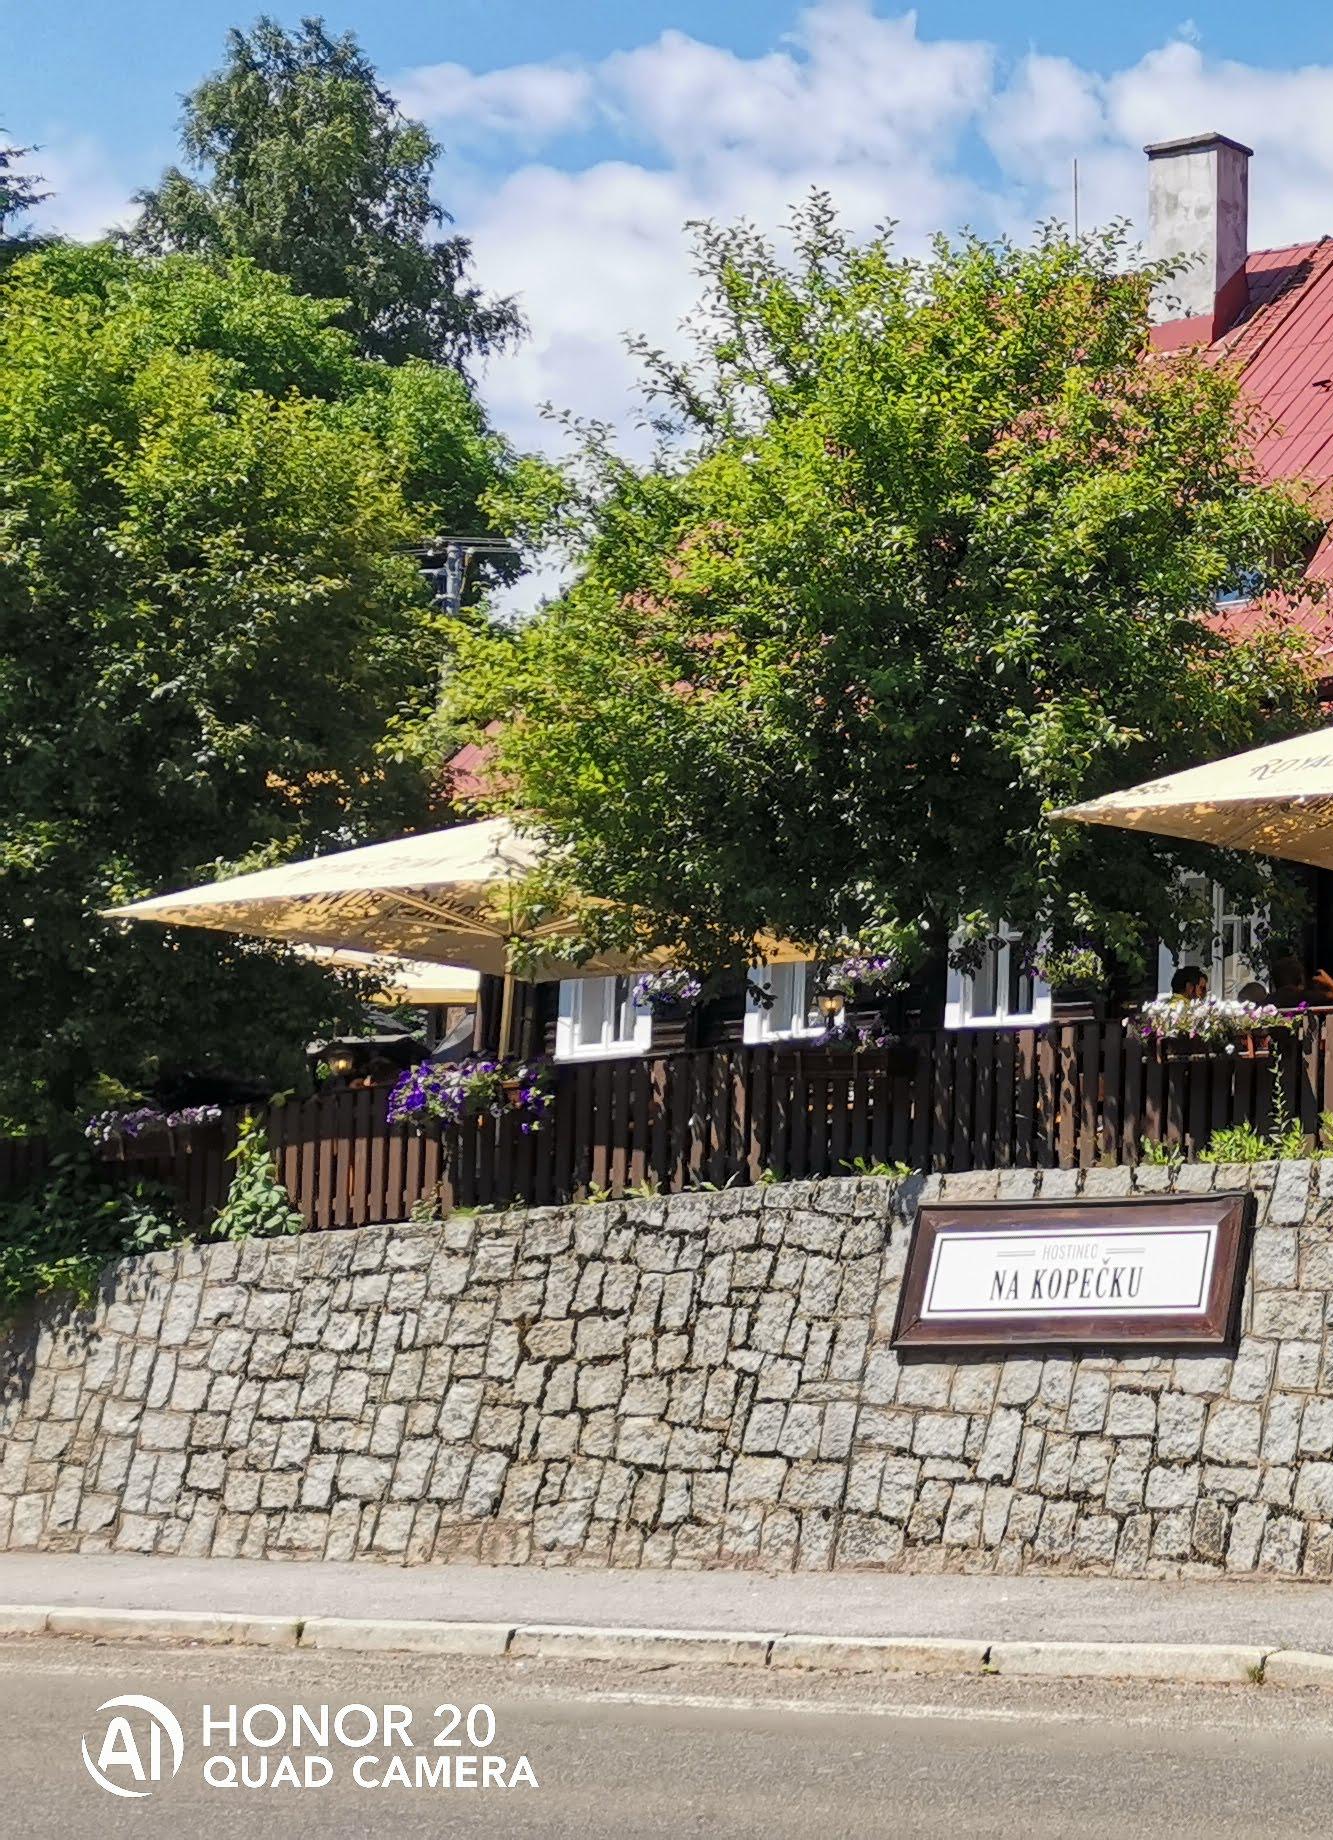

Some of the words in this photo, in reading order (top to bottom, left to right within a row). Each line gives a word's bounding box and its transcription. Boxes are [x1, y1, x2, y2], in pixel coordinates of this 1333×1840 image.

[1042, 1243, 1099, 1260] HOSTINEC
[989, 1269, 1019, 1301] NA
[1030, 1256, 1144, 1300] KOPEČKU
